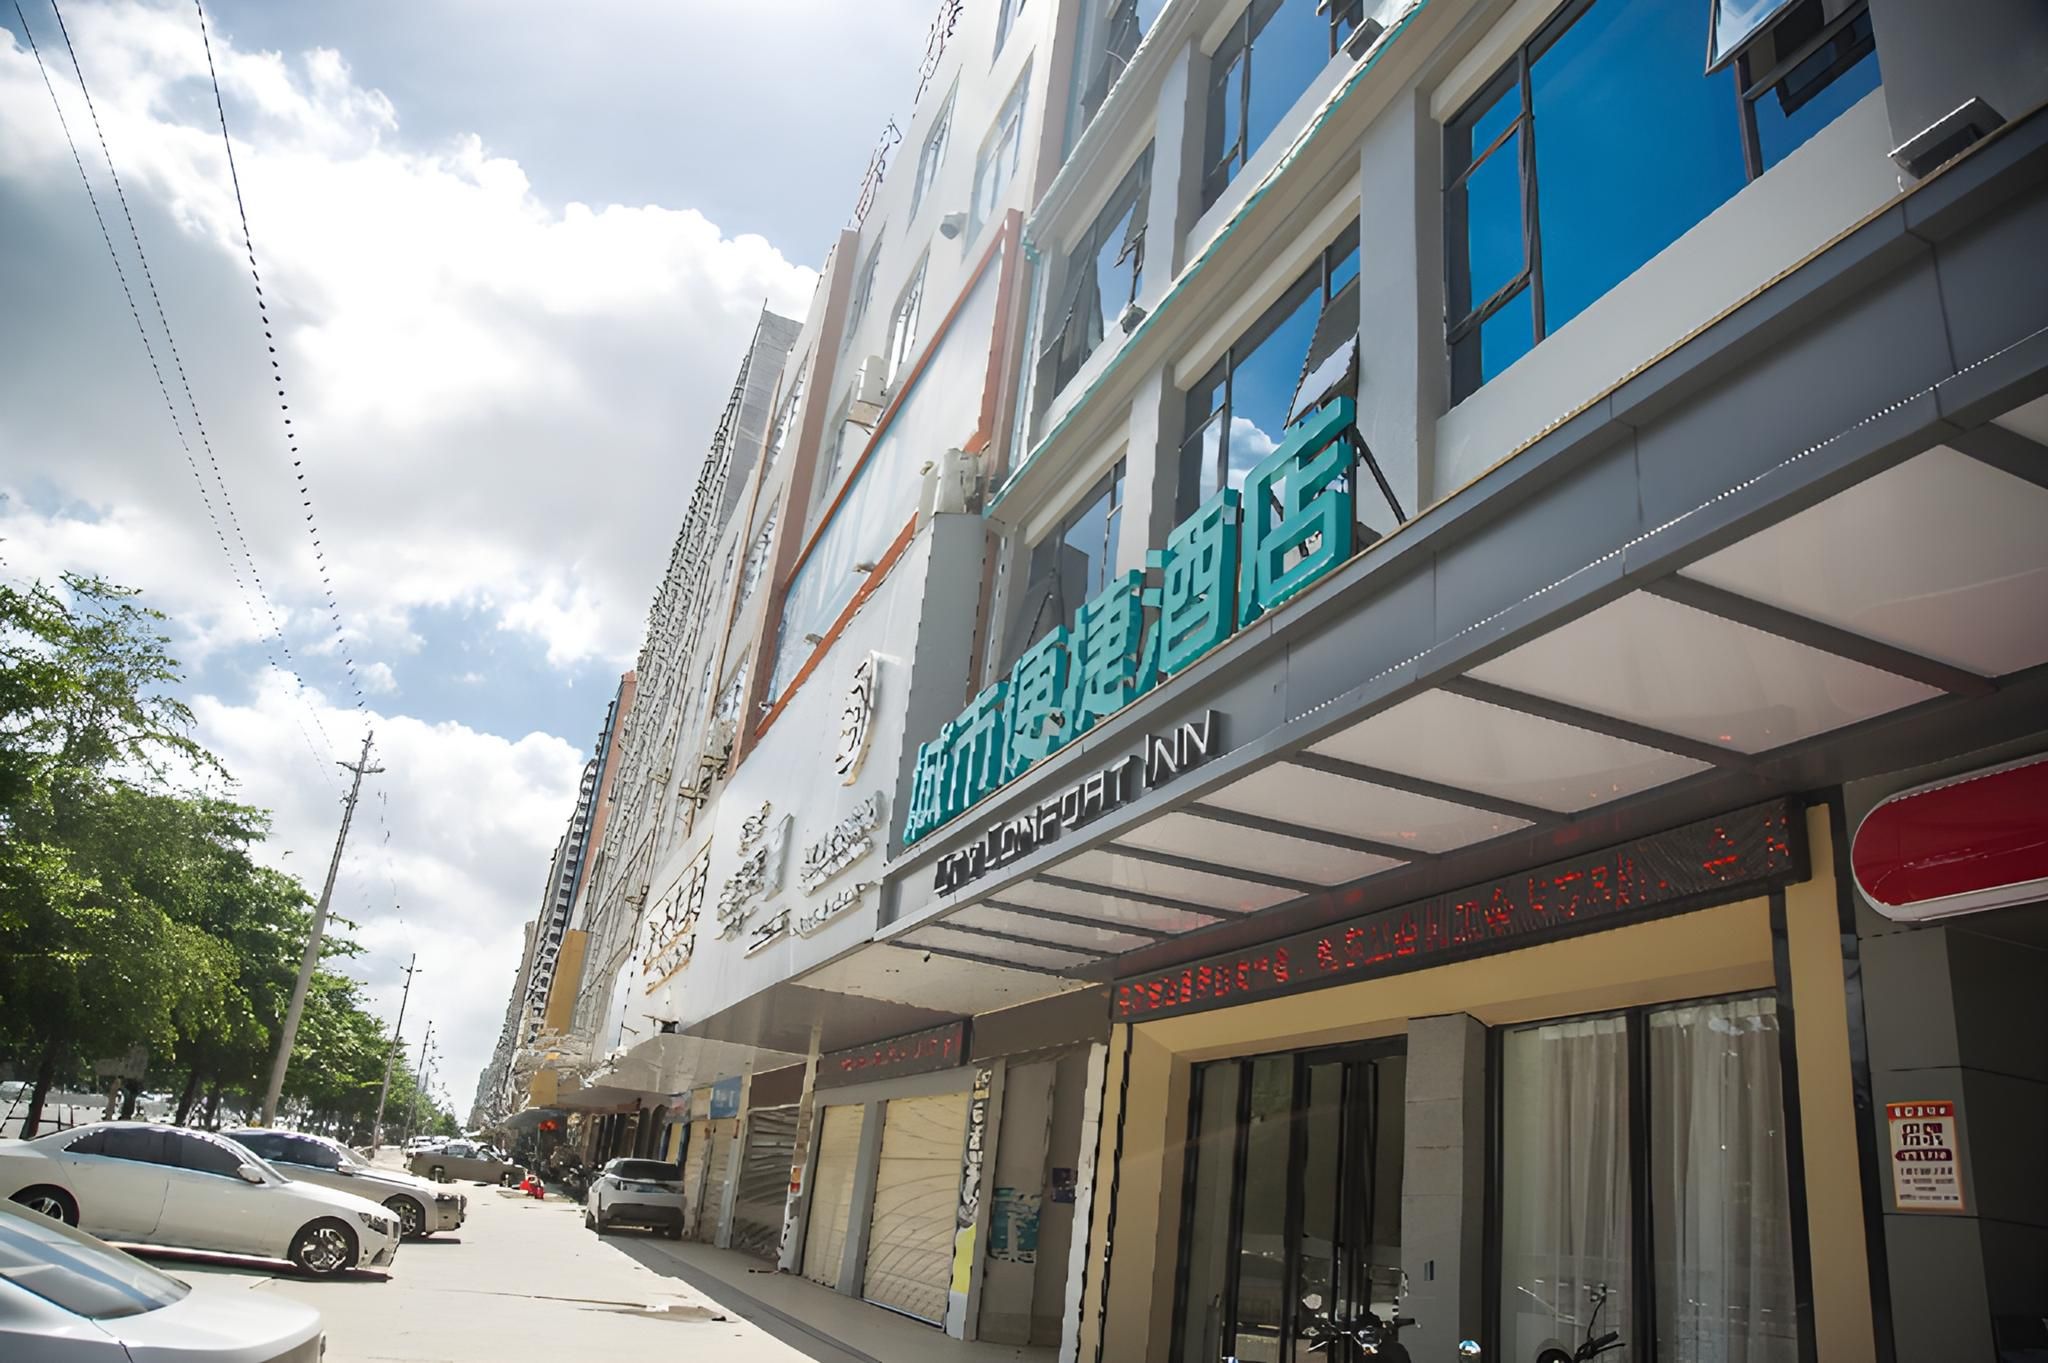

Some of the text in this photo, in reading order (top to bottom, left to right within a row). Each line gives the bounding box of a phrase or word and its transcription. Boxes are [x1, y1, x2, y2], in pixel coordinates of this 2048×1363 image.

[903, 396, 1356, 845] 城市便捷酒店
[1142, 710, 1213, 789] INN
